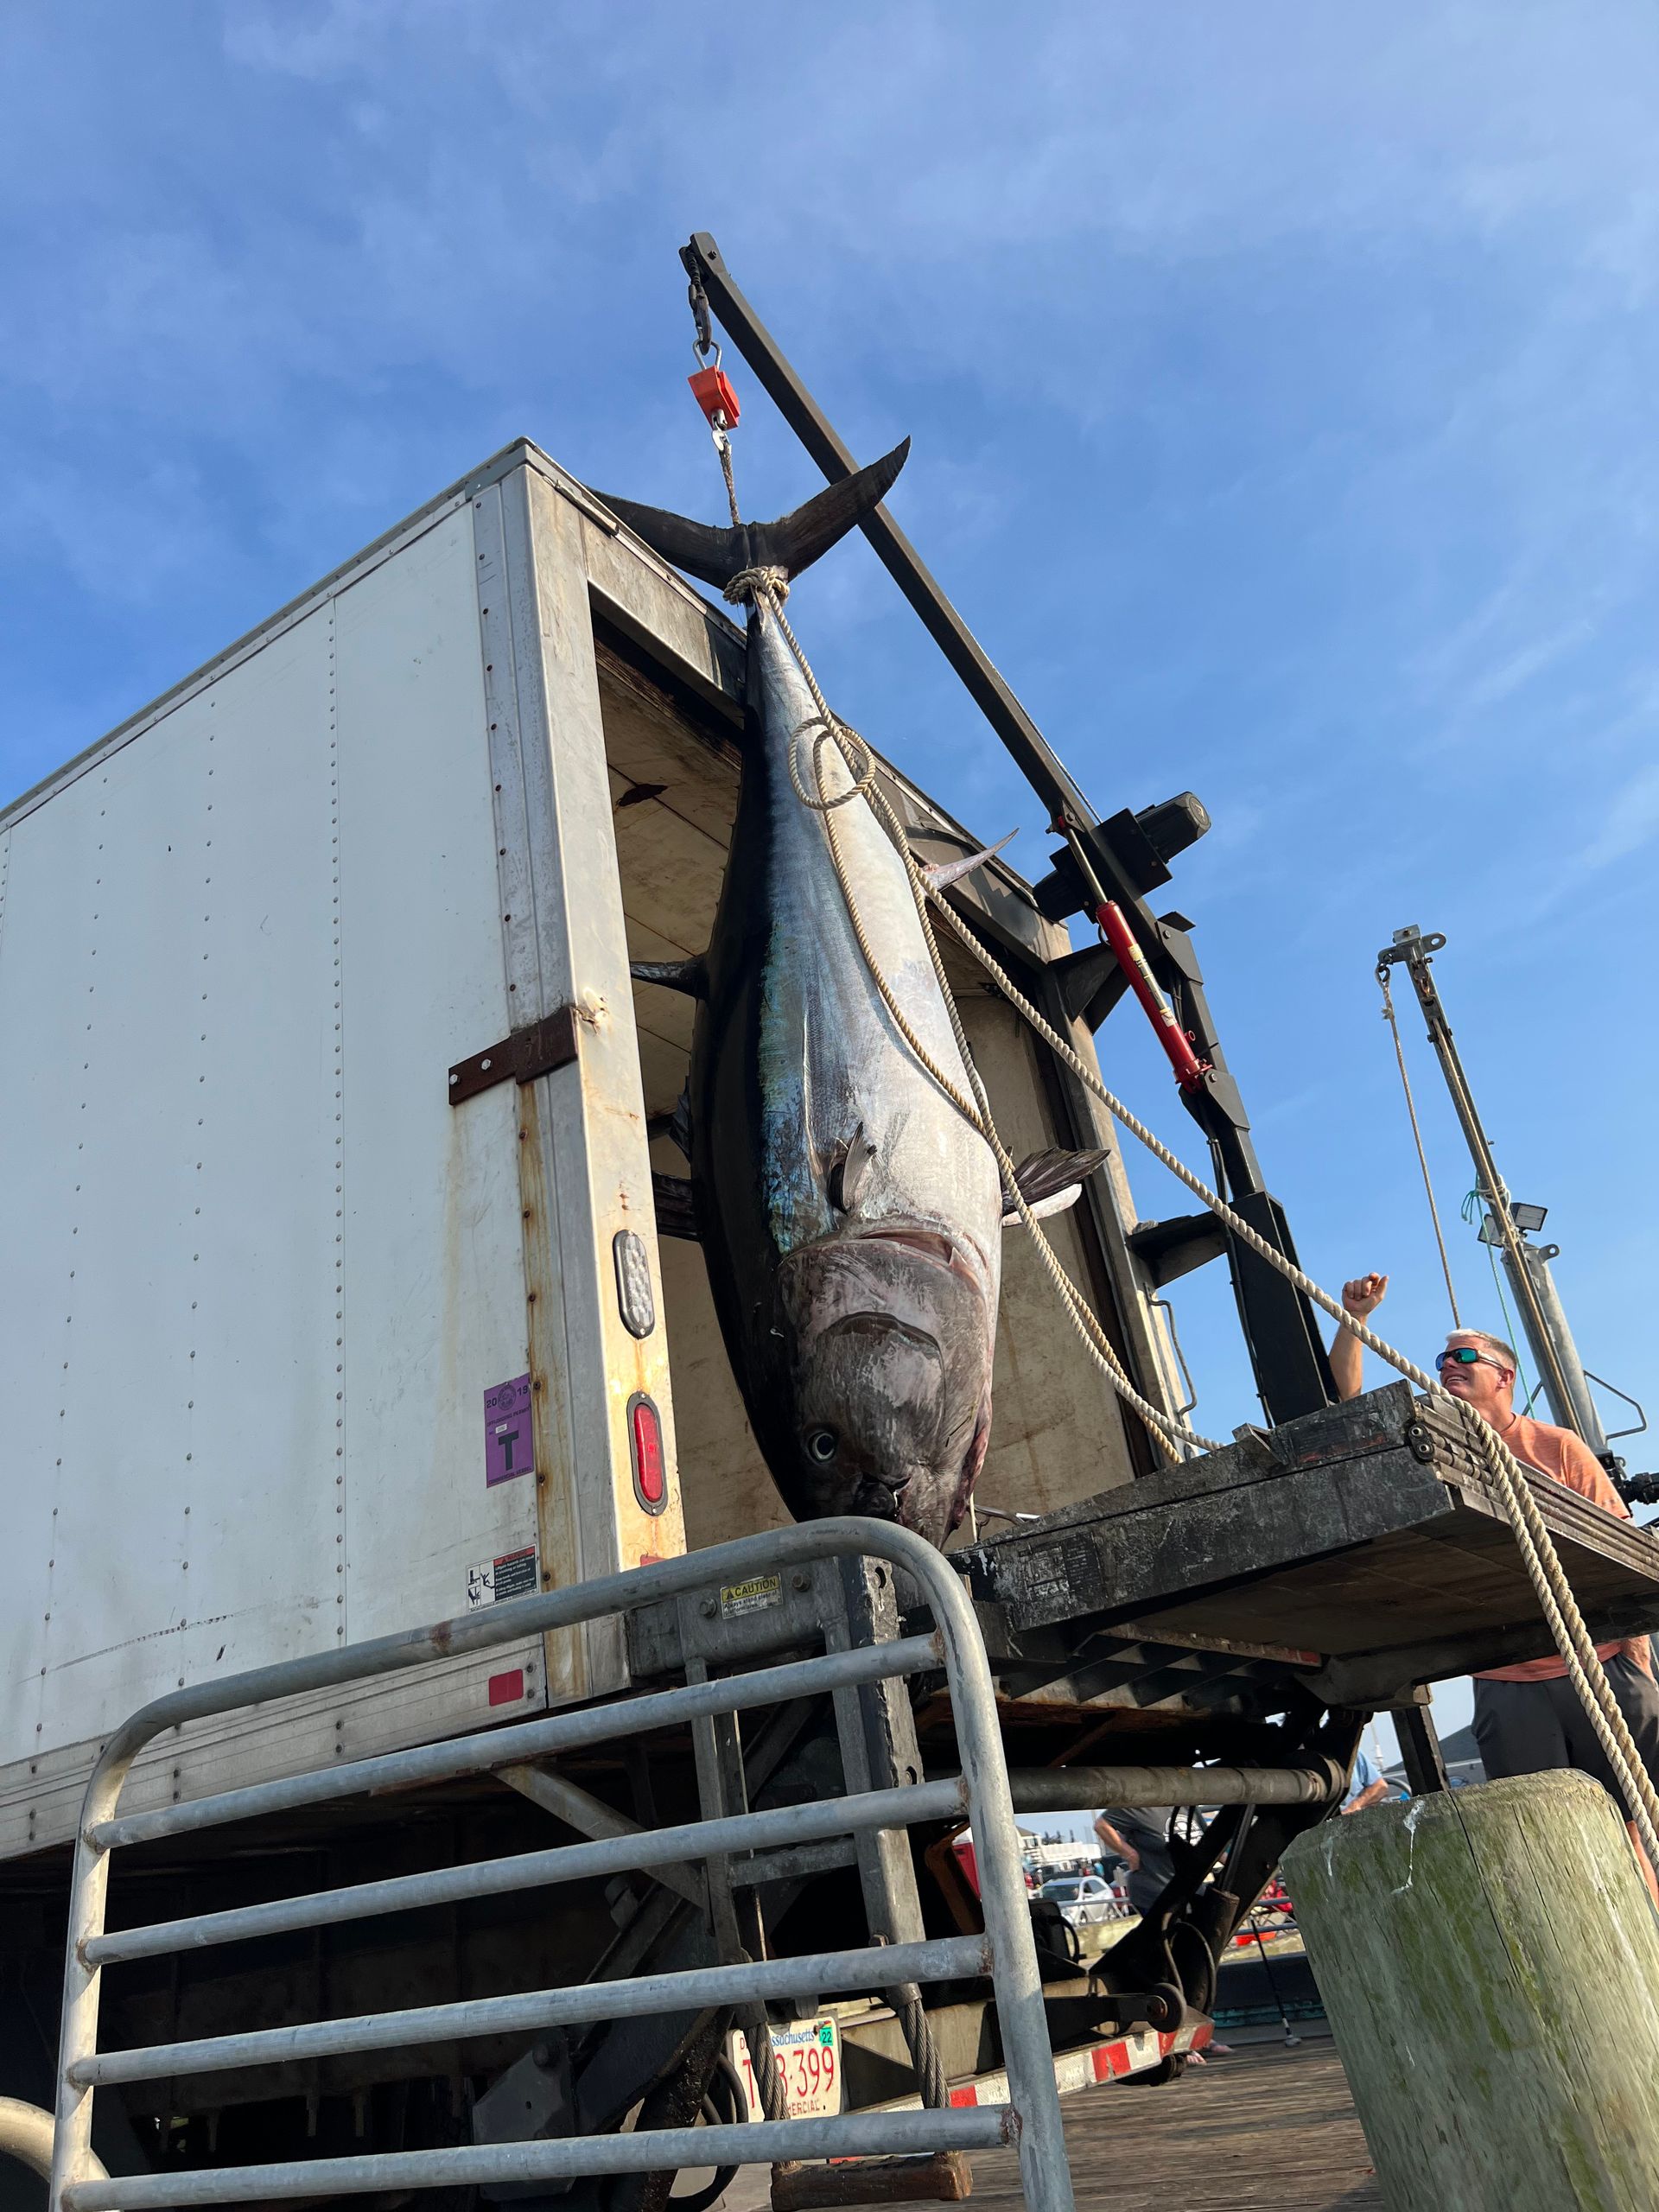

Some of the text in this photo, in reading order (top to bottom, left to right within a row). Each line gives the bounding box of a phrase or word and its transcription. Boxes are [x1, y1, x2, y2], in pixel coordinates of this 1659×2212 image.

[486, 1397, 498, 1409] 20
[517, 1385, 528, 1396] 19
[498, 1430, 519, 1471] T
[734, 1578, 776, 1597] CAUTION
[822, 2031, 832, 2044] 22
